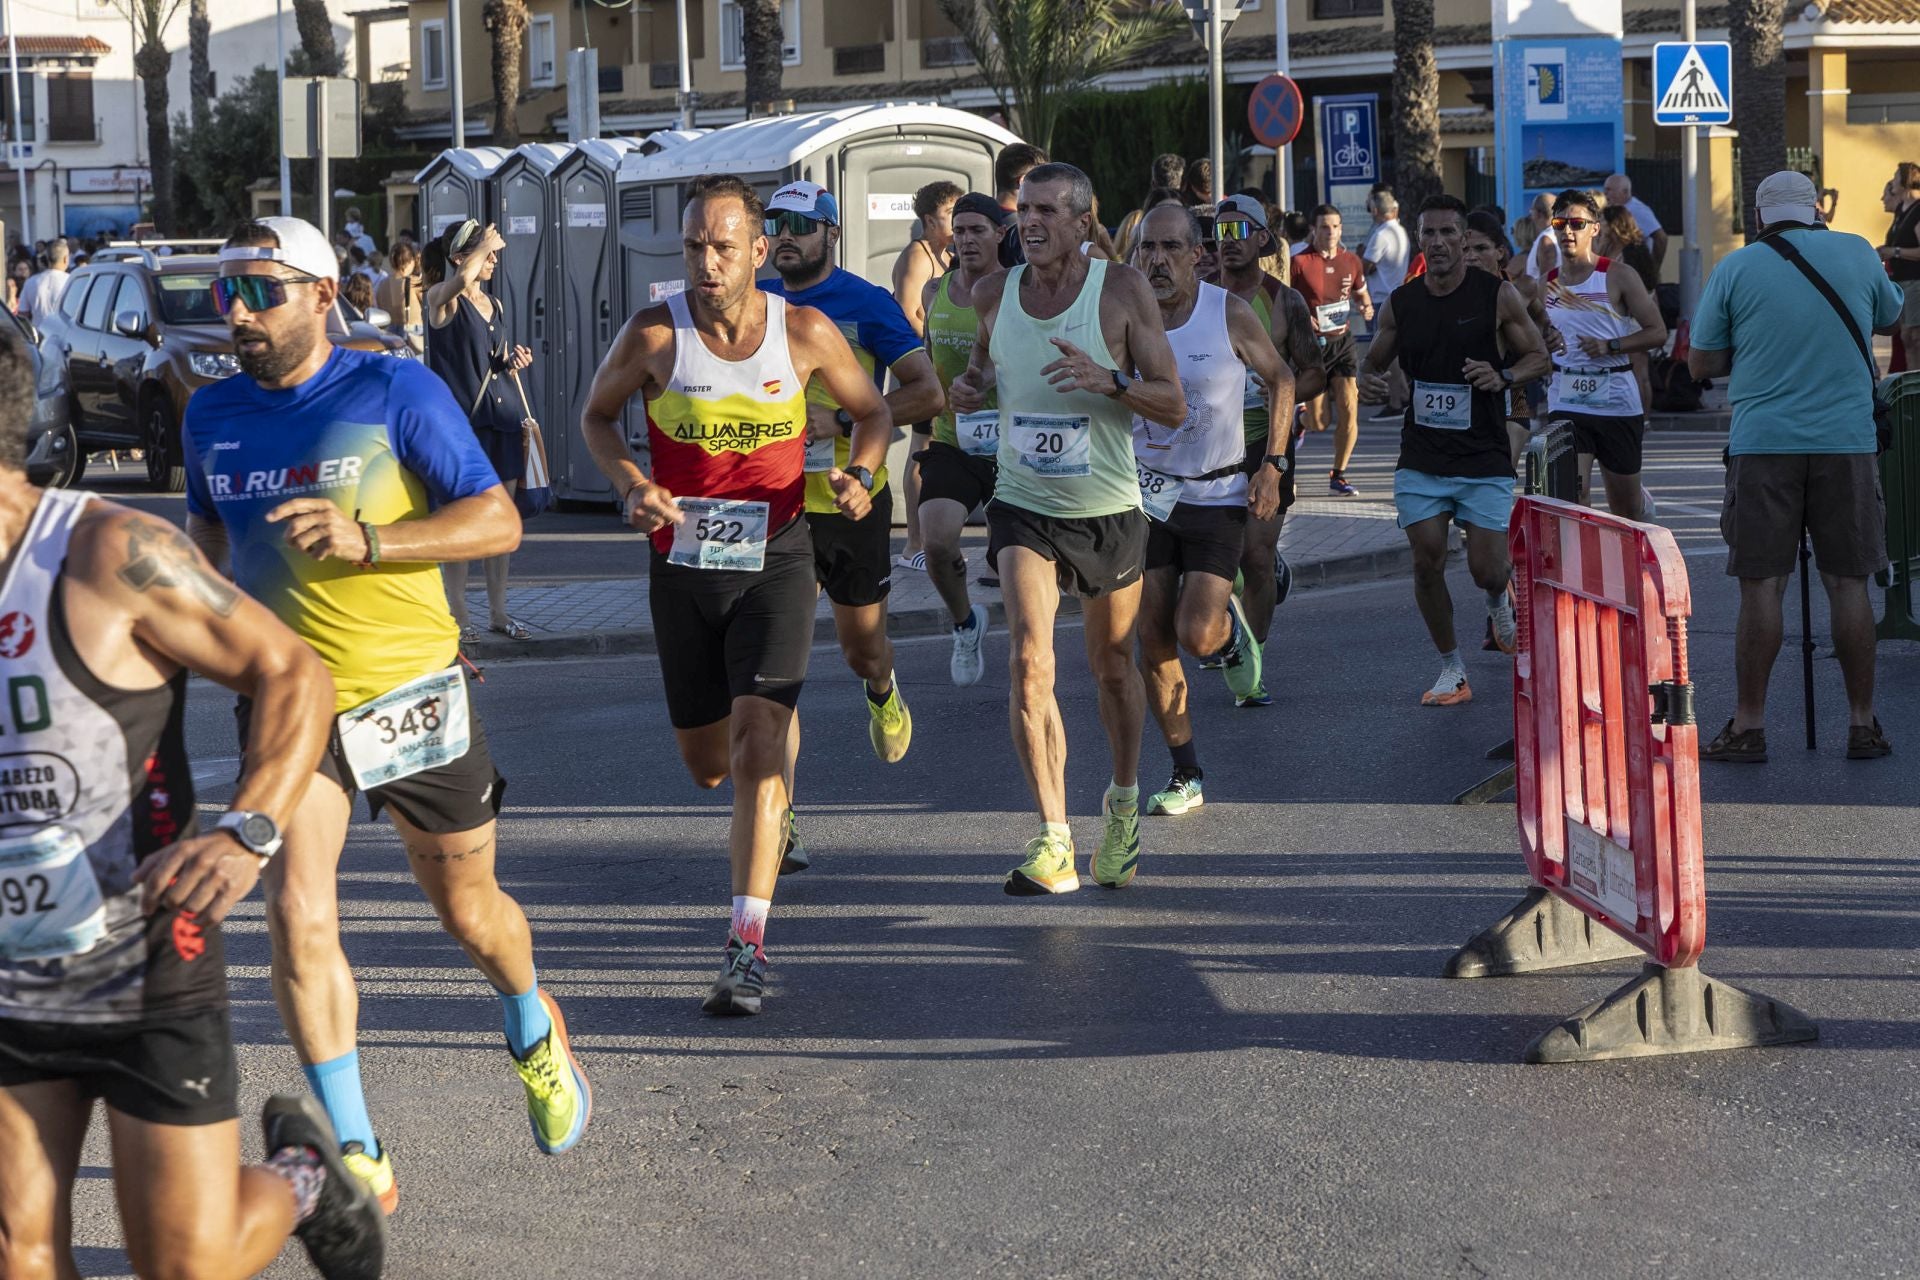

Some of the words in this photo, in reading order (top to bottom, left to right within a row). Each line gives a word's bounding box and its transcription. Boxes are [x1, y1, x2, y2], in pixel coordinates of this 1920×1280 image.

[1340, 274, 1352, 301] RAIL
[1572, 379, 1596, 392] 468
[1425, 394, 1456, 411] 219
[674, 421, 793, 440] ALUMBRES
[709, 438, 761, 451] SPORT
[1035, 433, 1063, 453] 20
[256, 490, 280, 498] TEAM
[696, 519, 743, 543] 522
[379, 697, 441, 744] 348
[0, 766, 55, 786] ABEZO
[0, 873, 57, 917] 92
